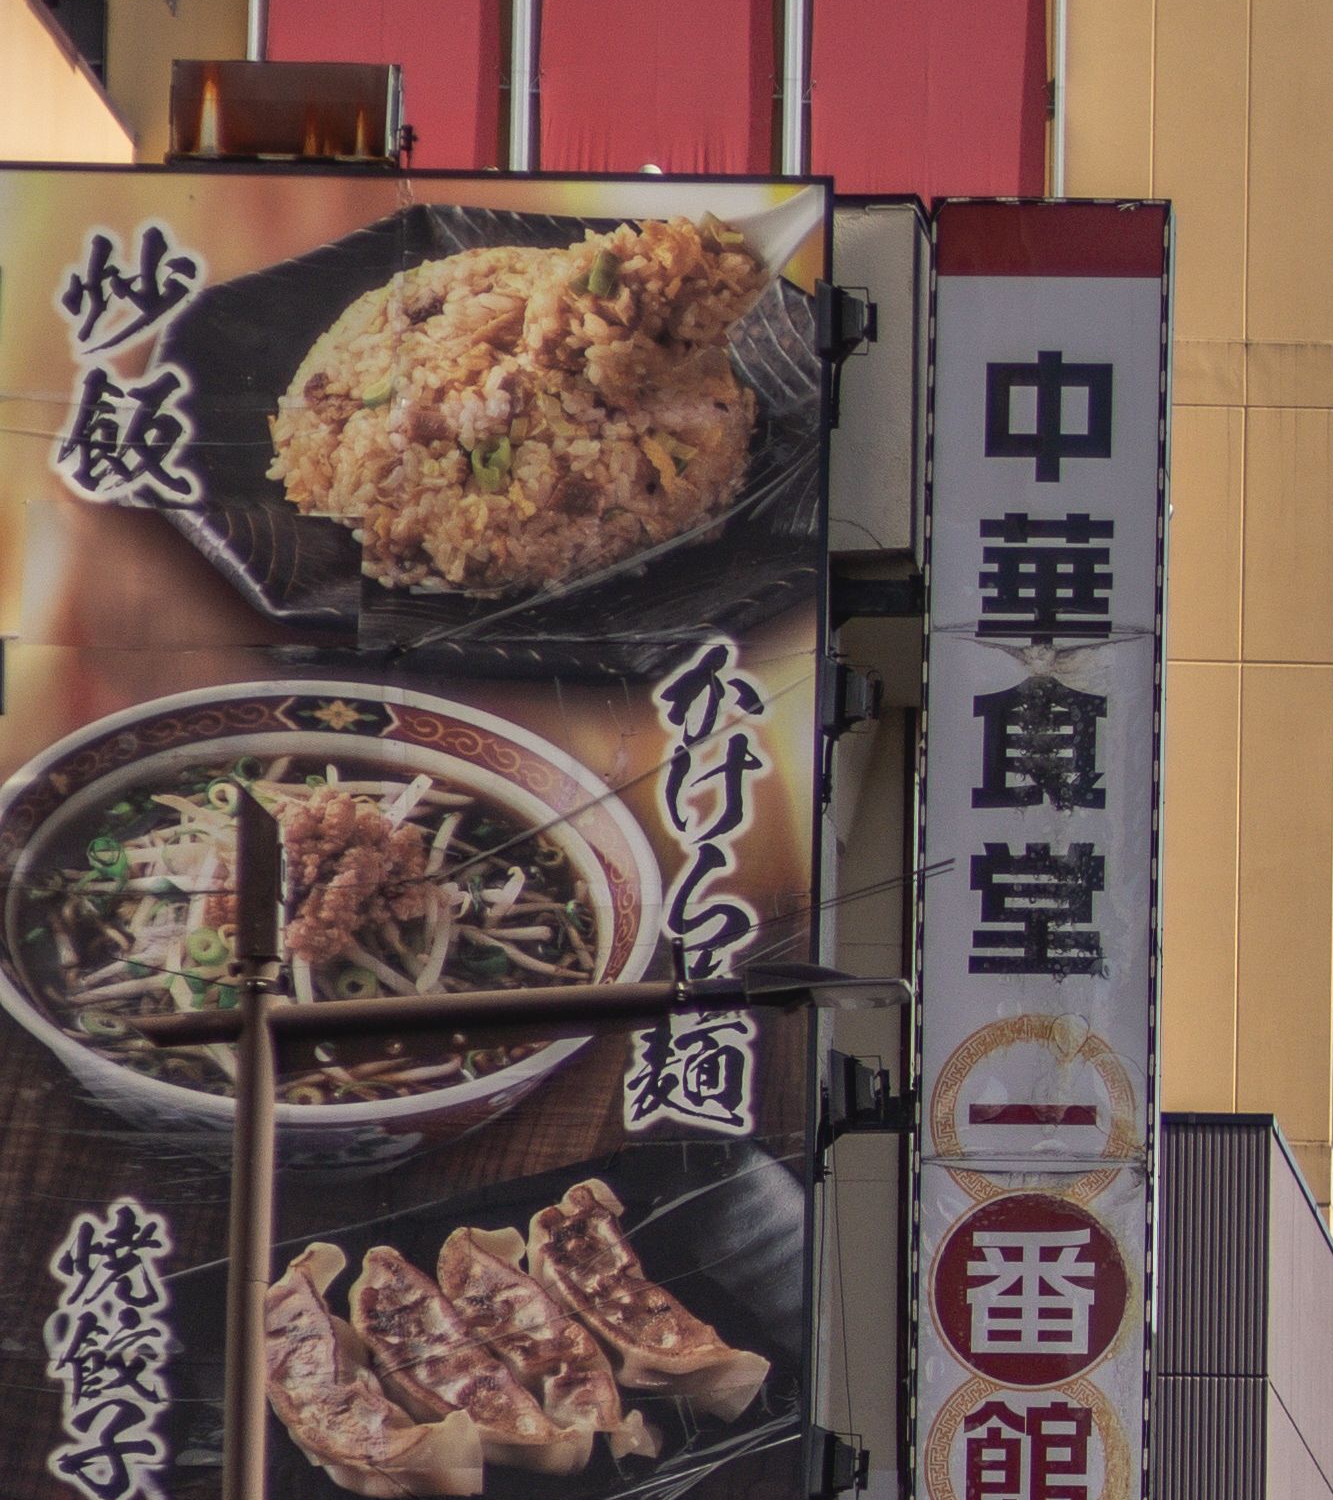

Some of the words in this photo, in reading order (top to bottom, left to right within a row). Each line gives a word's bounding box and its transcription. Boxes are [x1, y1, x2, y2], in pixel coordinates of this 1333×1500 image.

[58, 226, 196, 496] 炒飯
[969, 351, 1113, 976] 中華食堂
